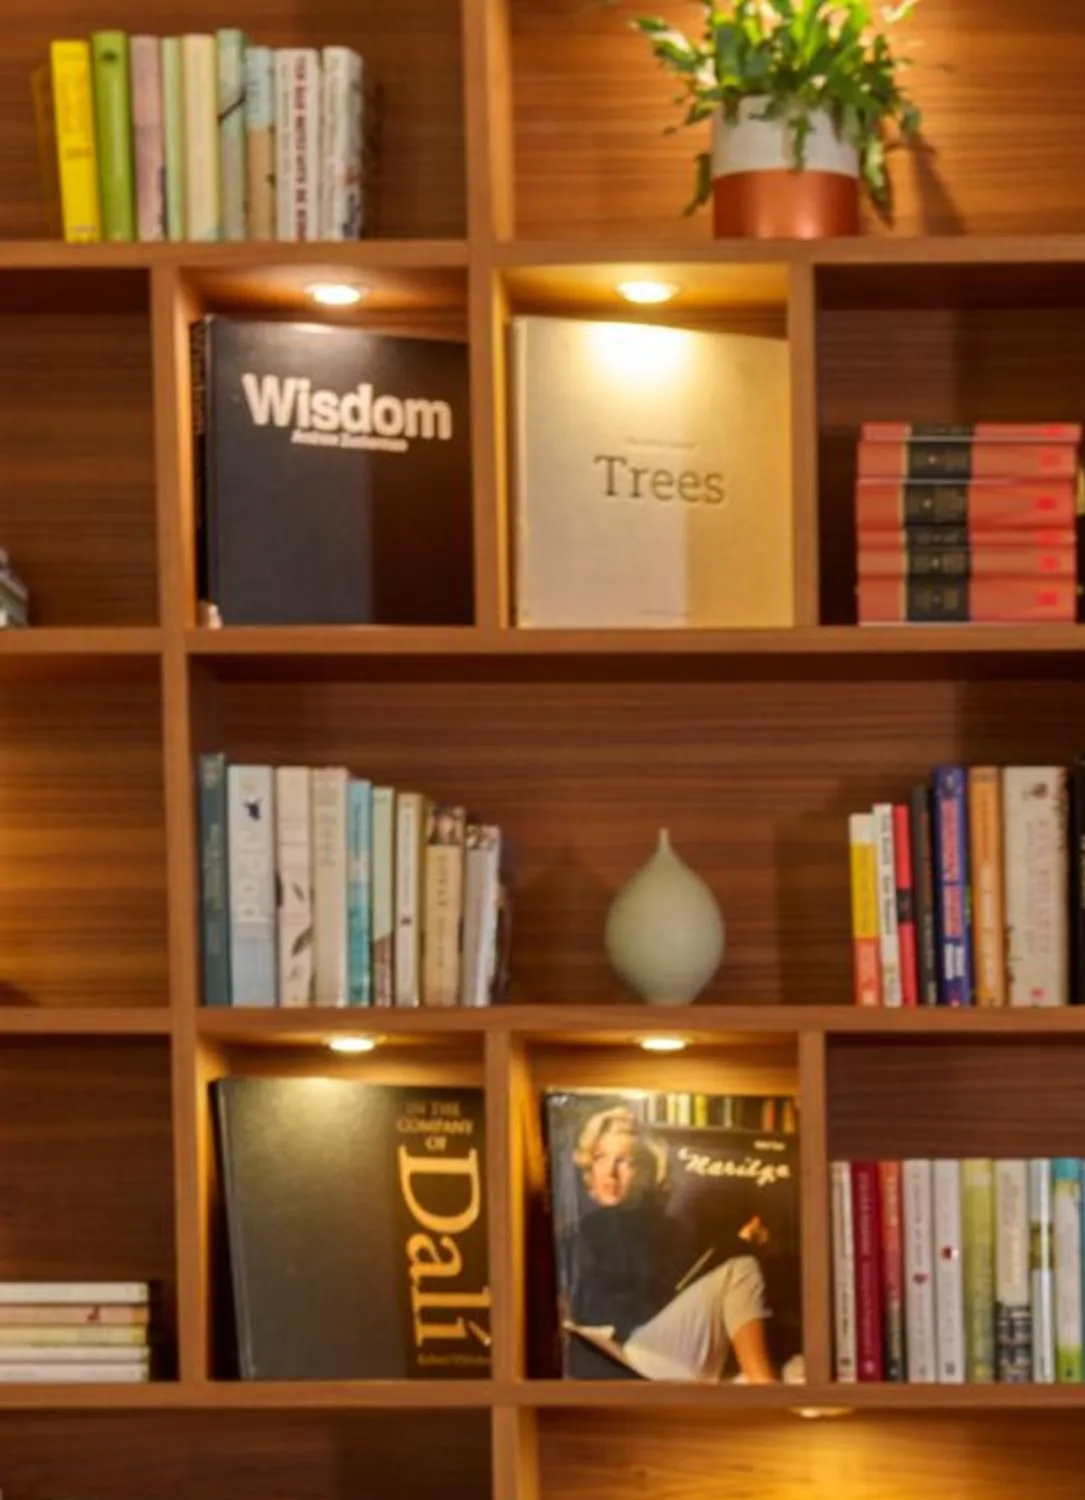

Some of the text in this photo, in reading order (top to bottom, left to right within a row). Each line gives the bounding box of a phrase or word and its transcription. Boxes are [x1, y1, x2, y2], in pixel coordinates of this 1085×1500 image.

[241, 372, 452, 440] Wisdom
[592, 454, 726, 506] Trees
[398, 1143, 492, 1348] Dalí
